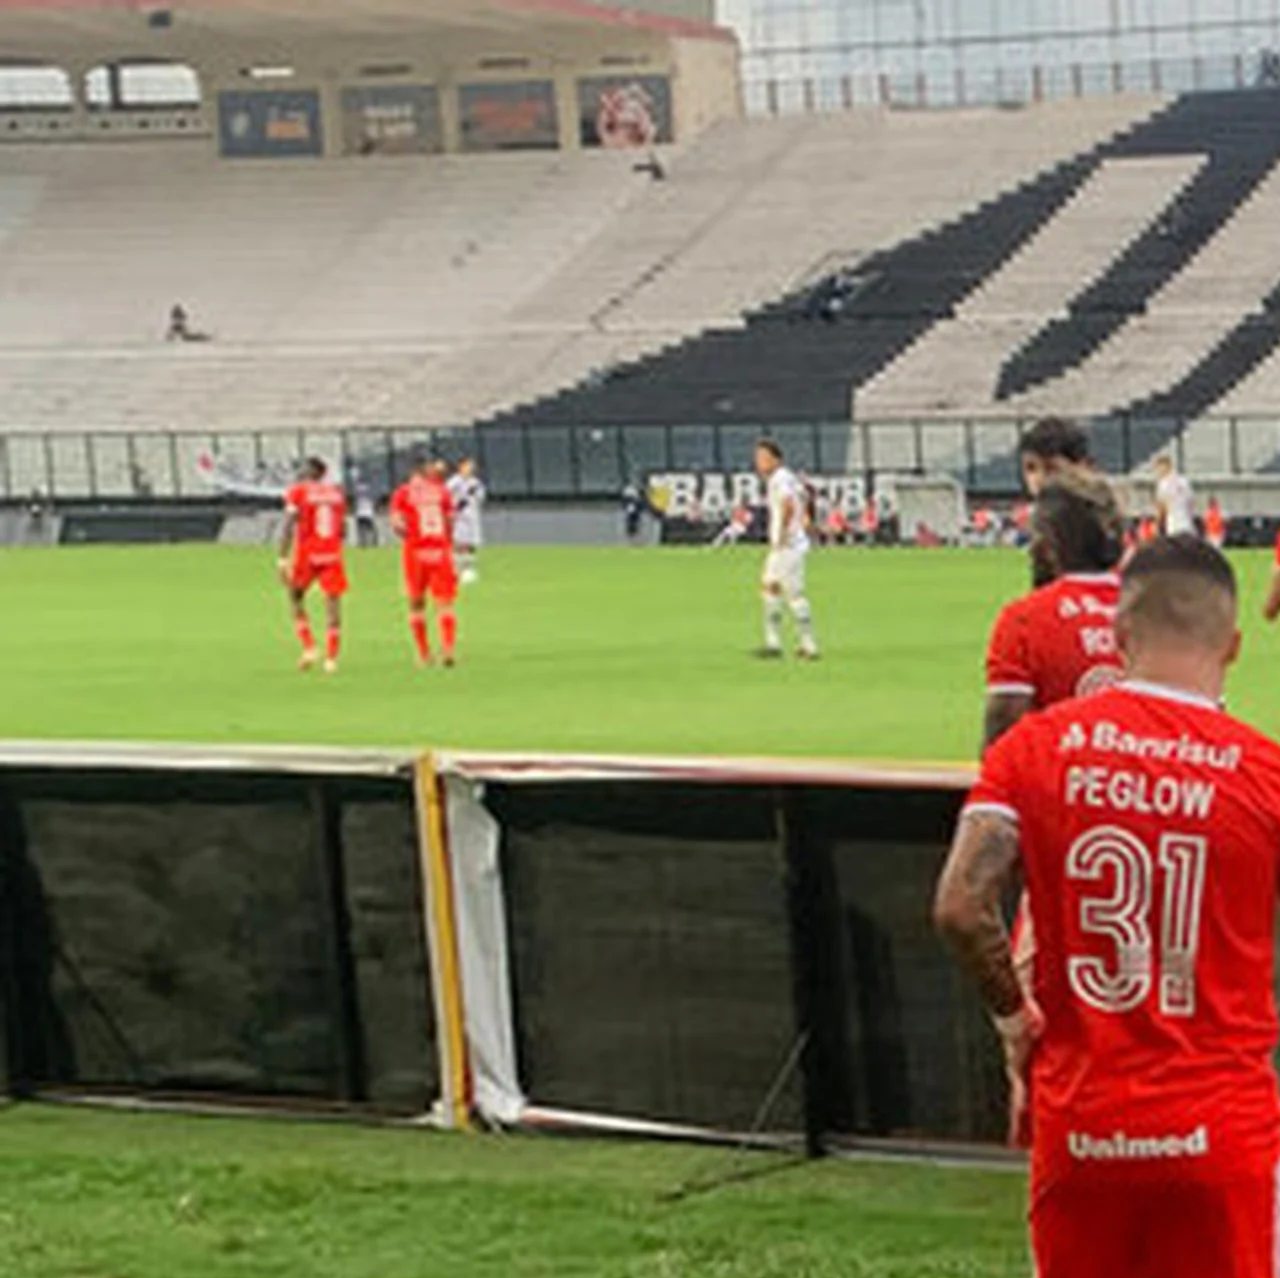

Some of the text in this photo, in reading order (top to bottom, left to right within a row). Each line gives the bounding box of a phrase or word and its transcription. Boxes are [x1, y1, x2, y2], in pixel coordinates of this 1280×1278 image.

[1091, 718, 1242, 772] Banrisul
[1065, 765, 1216, 820] PEGLOW
[1066, 825, 1207, 1017] 31
[1067, 1125, 1208, 1159] Unimed
